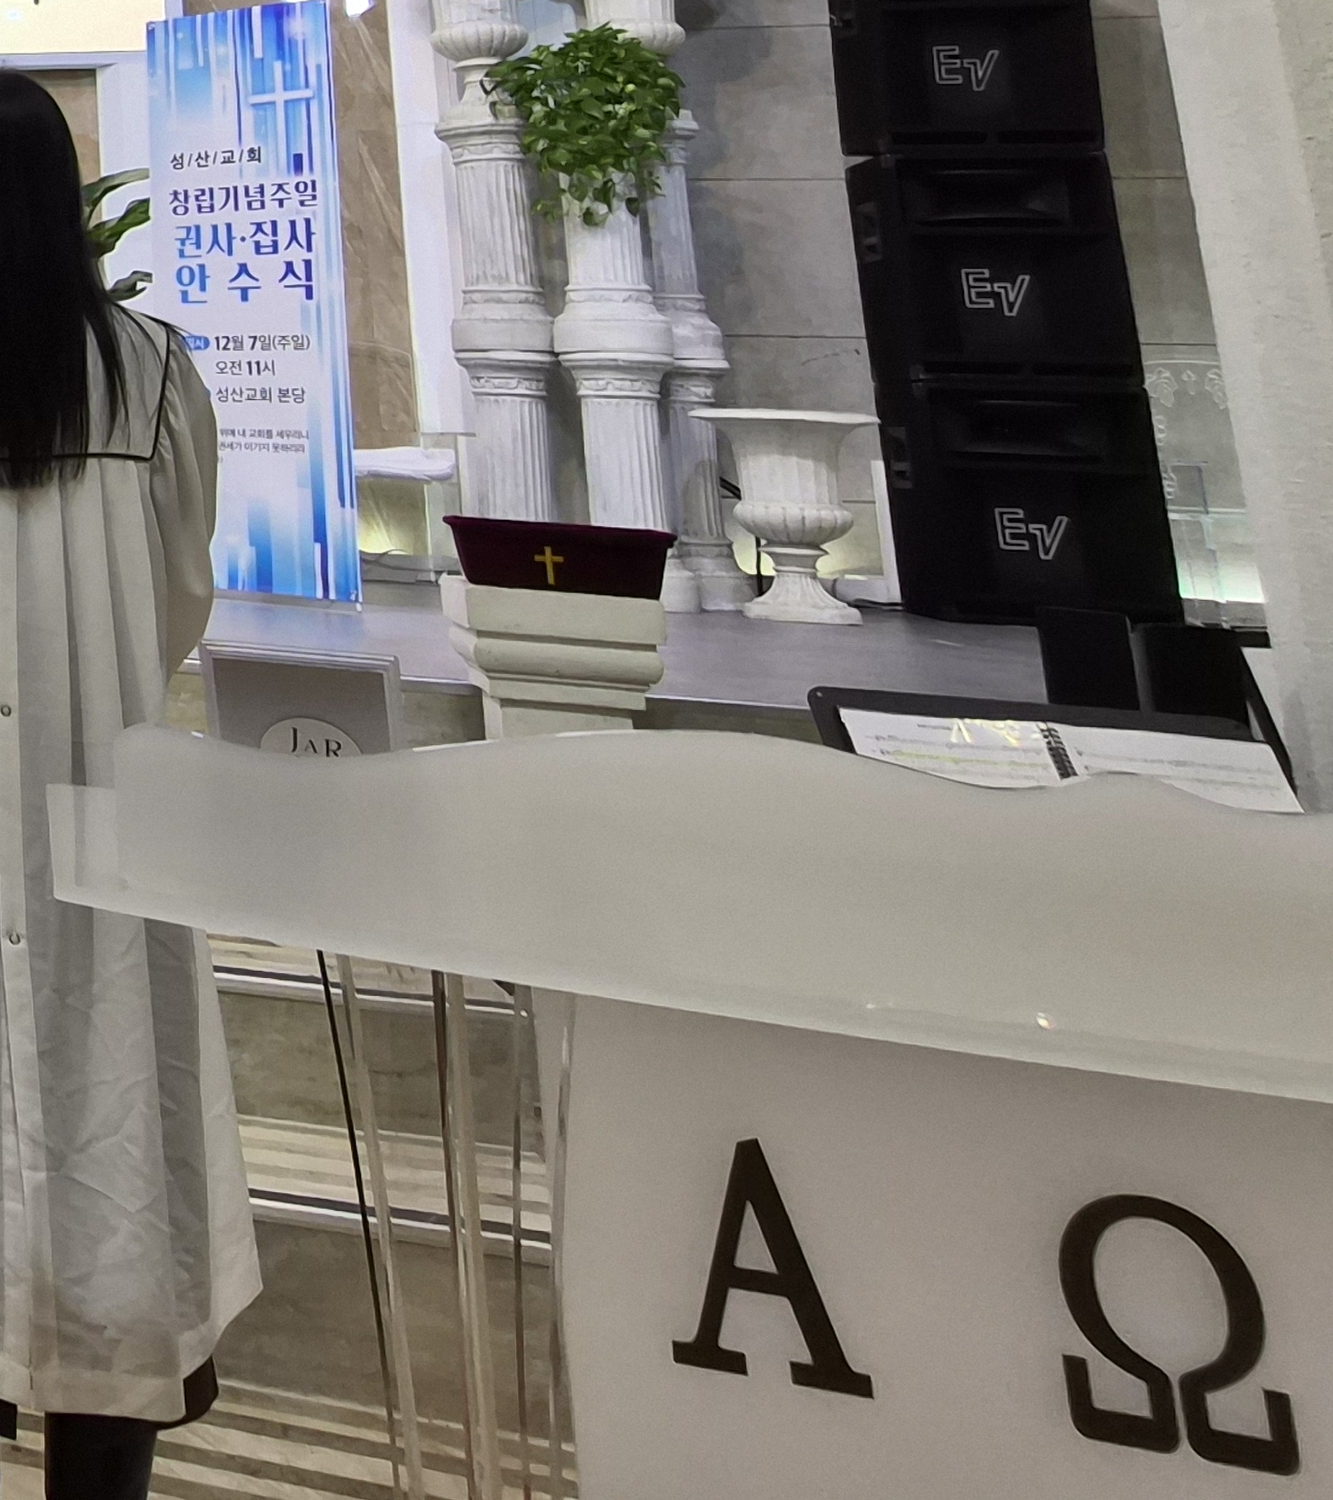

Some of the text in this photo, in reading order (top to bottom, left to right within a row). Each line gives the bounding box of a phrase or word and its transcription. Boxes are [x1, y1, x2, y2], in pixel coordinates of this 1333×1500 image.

[169, 179, 318, 216] 창립기념주일
[214, 335, 244, 351] 12월
[248, 334, 311, 351] 7일(주일)
[215, 359, 276, 376] 오전 11시
[216, 386, 305, 404] 성산교회 본당
[292, 727, 342, 757] JAR
[1059, 1194, 1301, 1476] Ω
